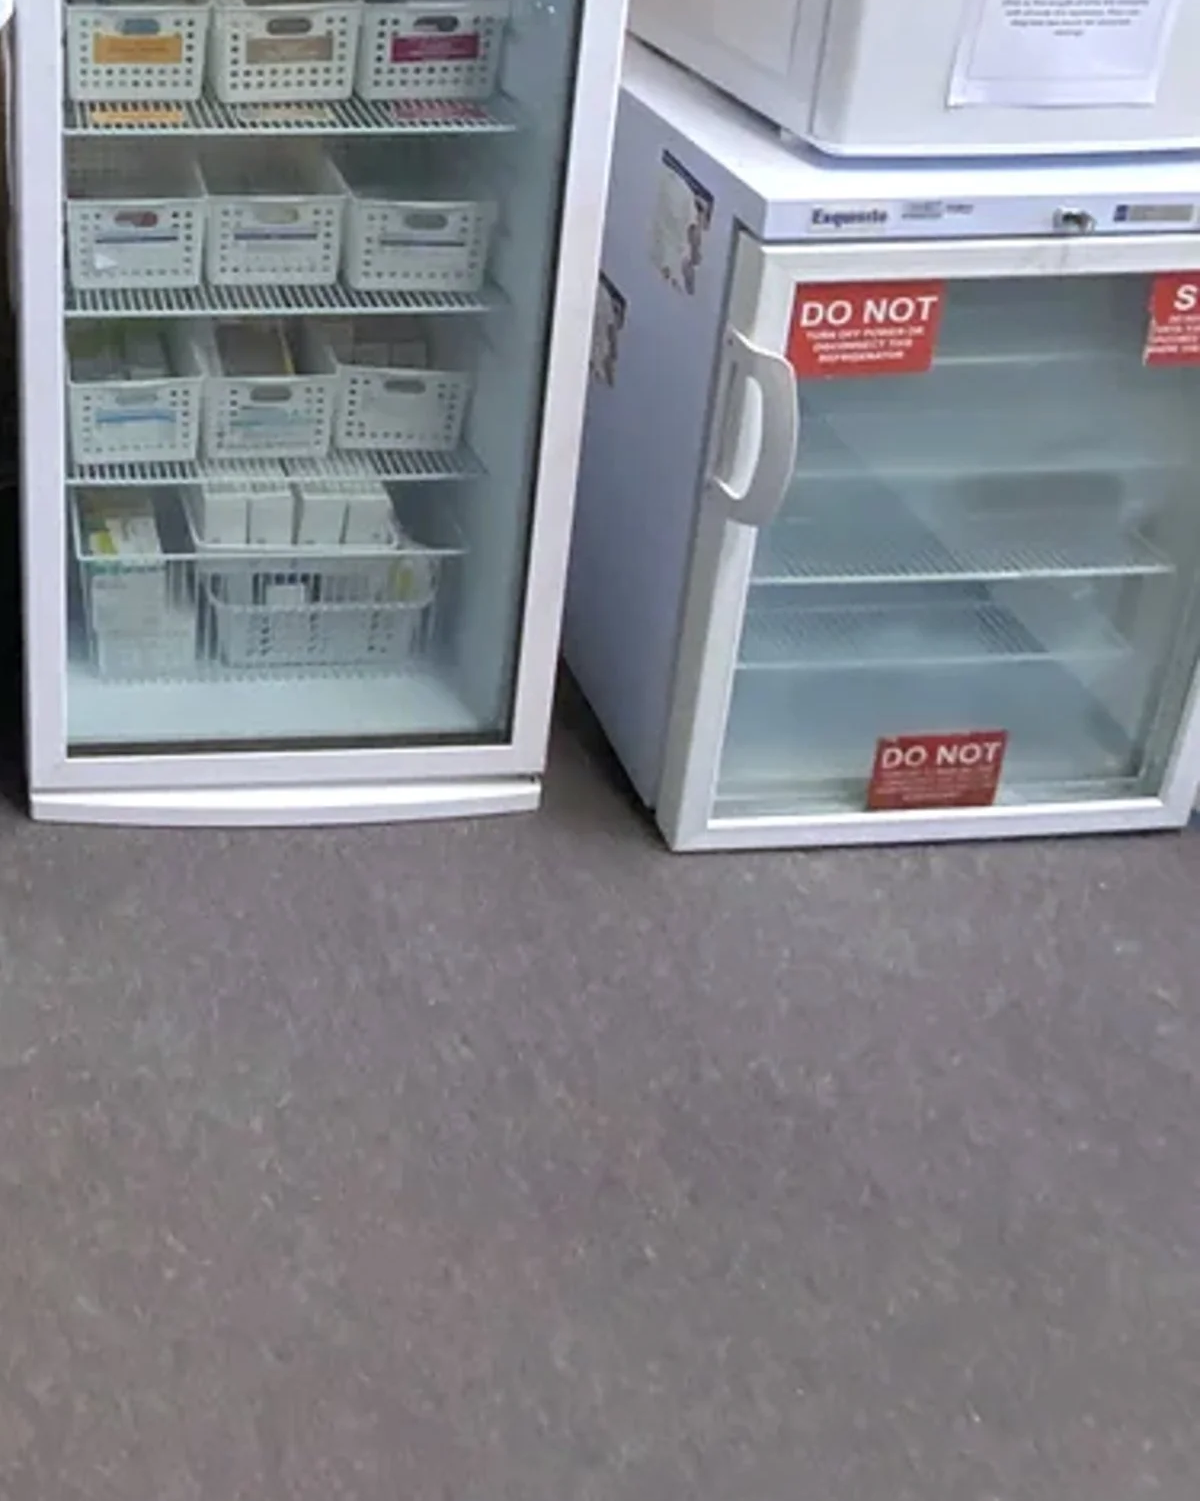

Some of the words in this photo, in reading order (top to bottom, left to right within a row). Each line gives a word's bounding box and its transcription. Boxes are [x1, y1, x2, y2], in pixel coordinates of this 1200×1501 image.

[800, 300, 853, 327] DO
[863, 295, 939, 324] NOT
[863, 326, 907, 337] POWER
[881, 745, 928, 769] DO
[936, 741, 1002, 766] NOT
